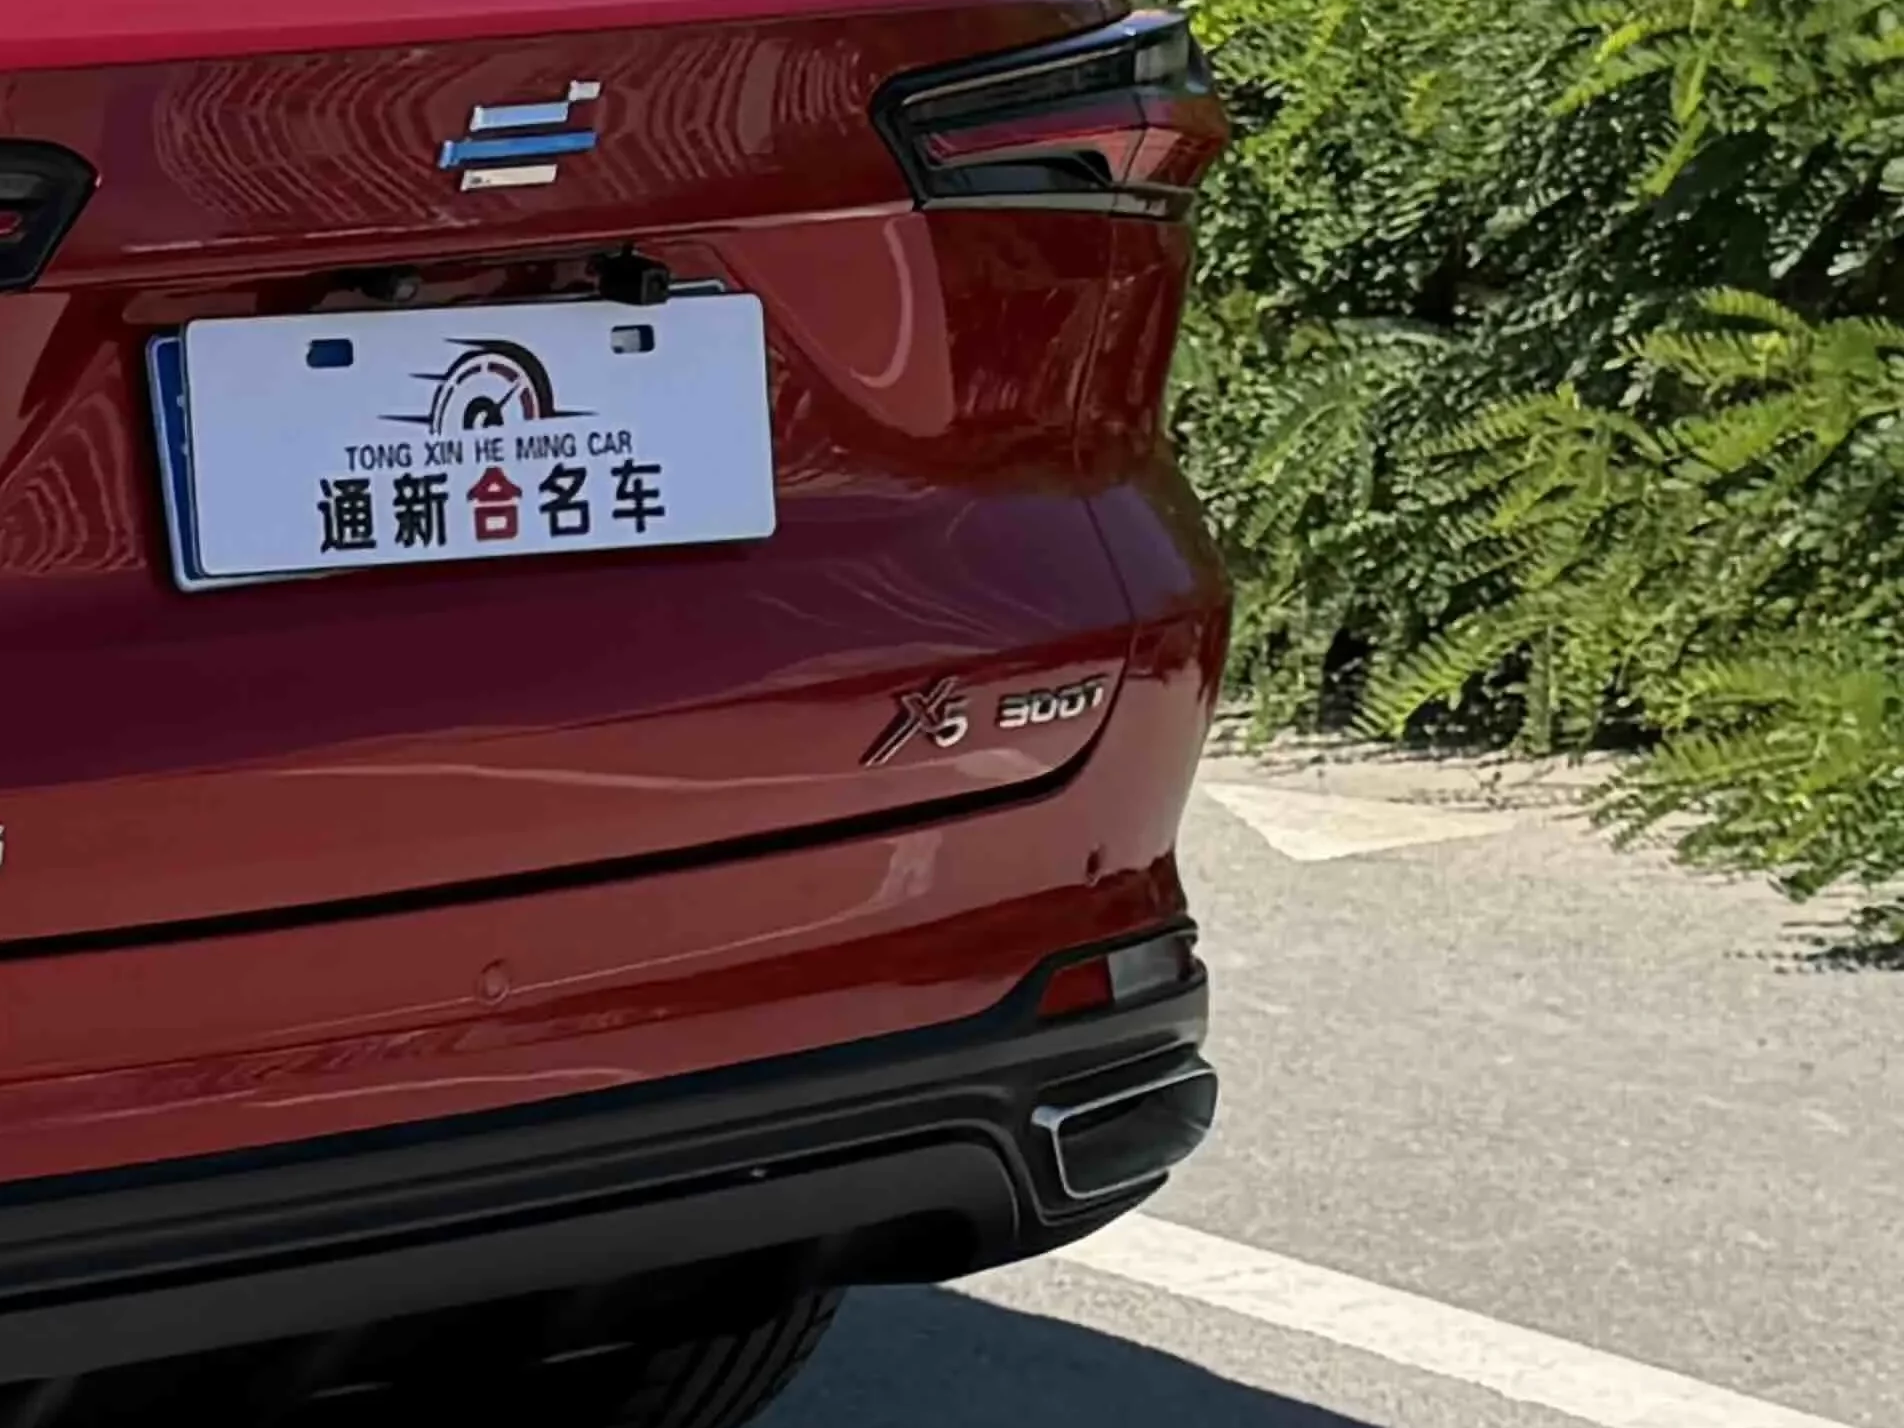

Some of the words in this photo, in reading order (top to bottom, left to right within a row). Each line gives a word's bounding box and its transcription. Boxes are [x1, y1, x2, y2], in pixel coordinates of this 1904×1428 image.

[345, 445, 413, 471] TONG
[424, 440, 463, 466] XIN
[475, 437, 505, 463] HE
[516, 434, 577, 460] MING
[587, 430, 633, 456] CAR
[317, 458, 666, 553] 通新合名车
